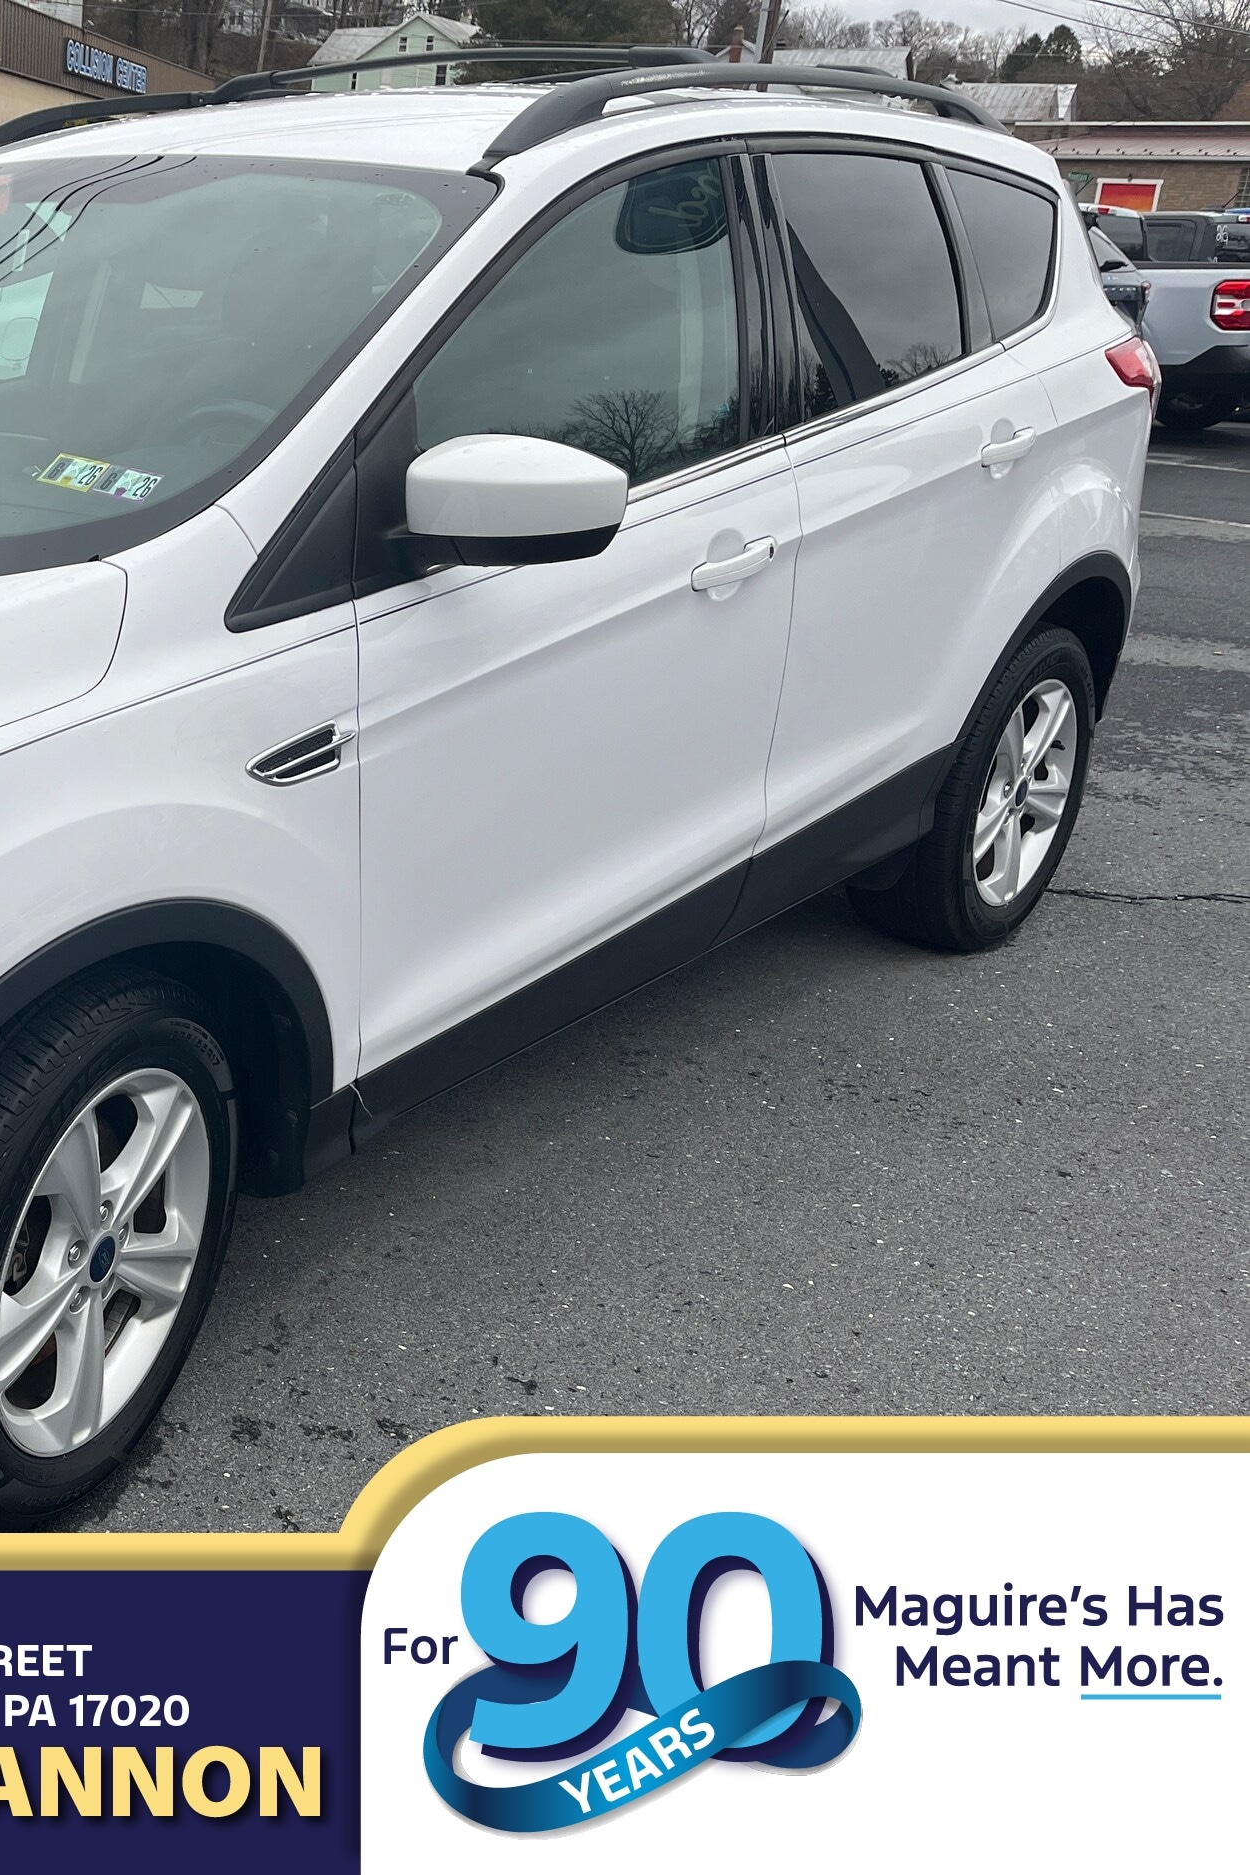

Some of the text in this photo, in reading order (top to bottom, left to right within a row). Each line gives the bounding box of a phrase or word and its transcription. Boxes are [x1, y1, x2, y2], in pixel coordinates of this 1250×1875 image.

[66, 39, 147, 94] COLLISION CENTER
[47, 461, 104, 486] 6 26
[99, 471, 158, 498] 6 26
